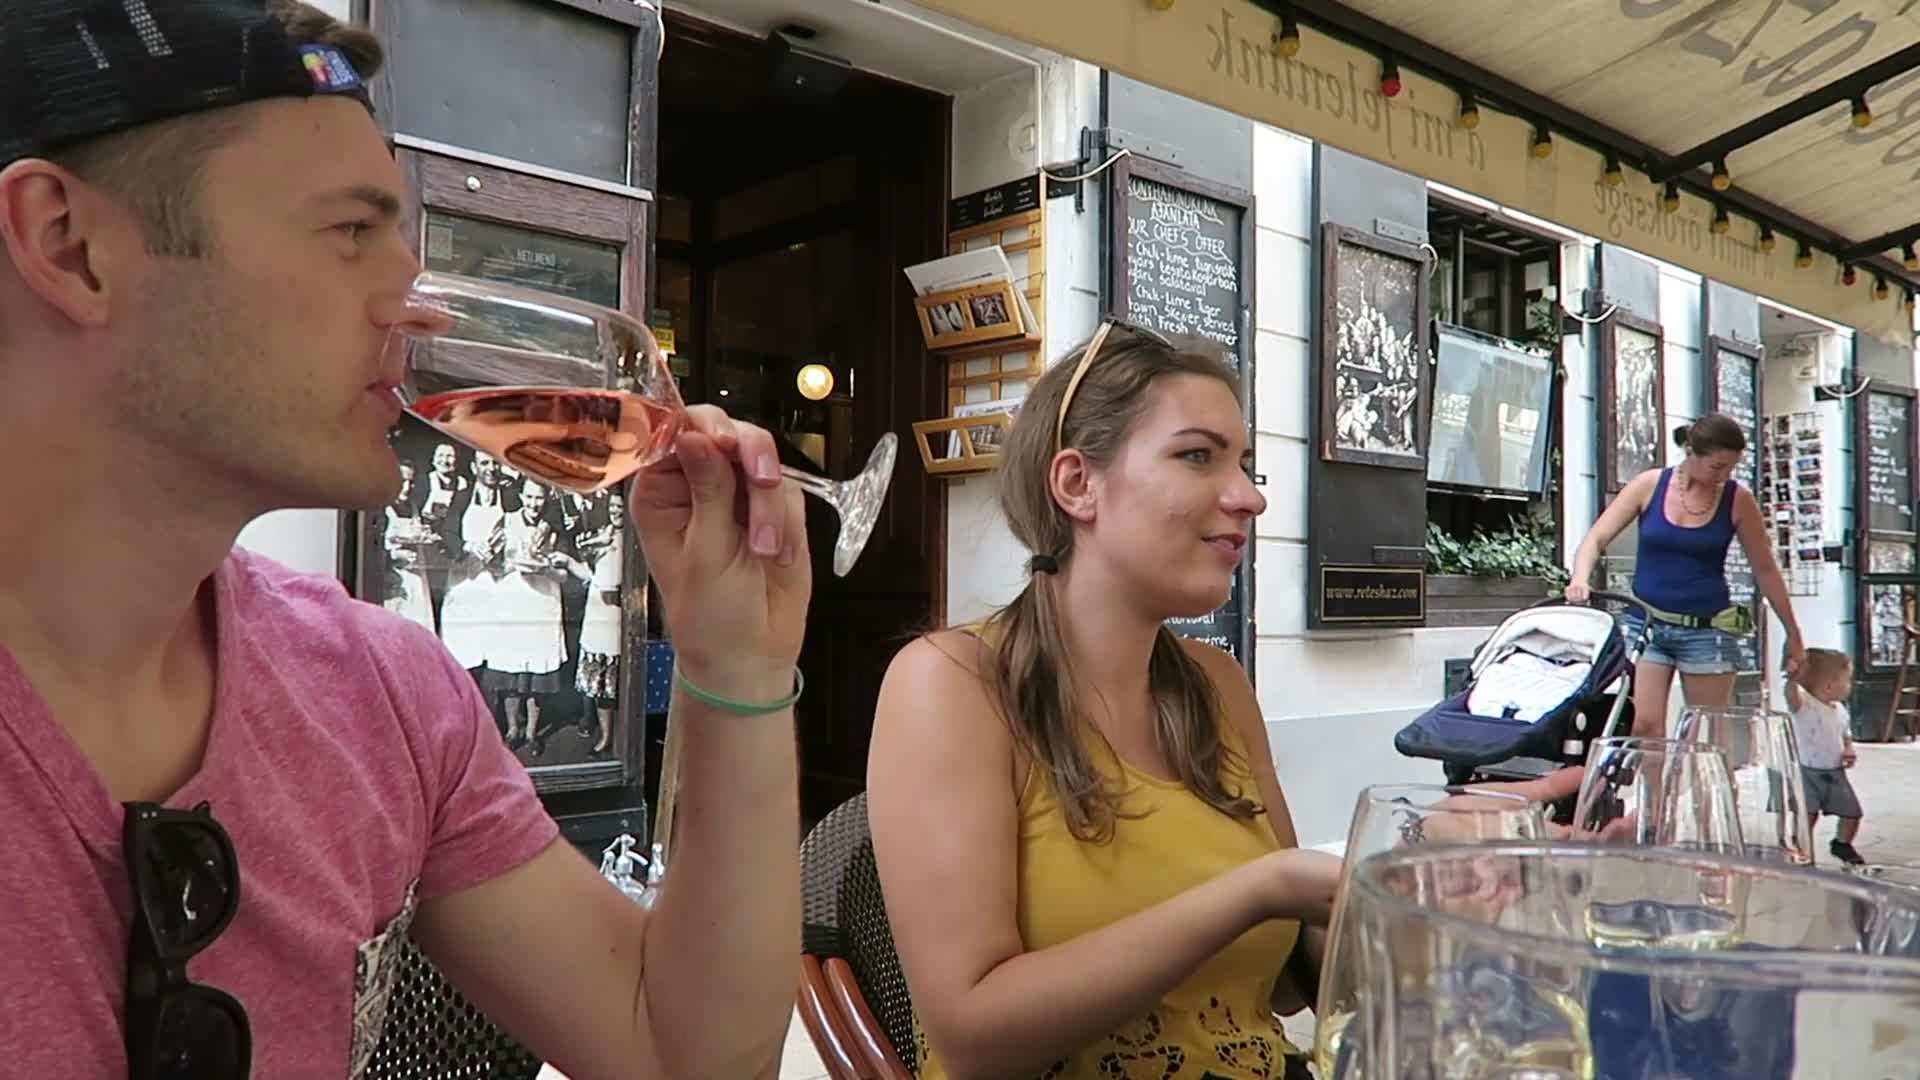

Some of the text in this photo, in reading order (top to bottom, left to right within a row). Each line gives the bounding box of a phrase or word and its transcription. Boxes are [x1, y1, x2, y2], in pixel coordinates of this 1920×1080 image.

[1153, 222, 1189, 247] CHEF'S
[1195, 233, 1226, 258] OFFER
[1158, 314, 1188, 335] Fresh
